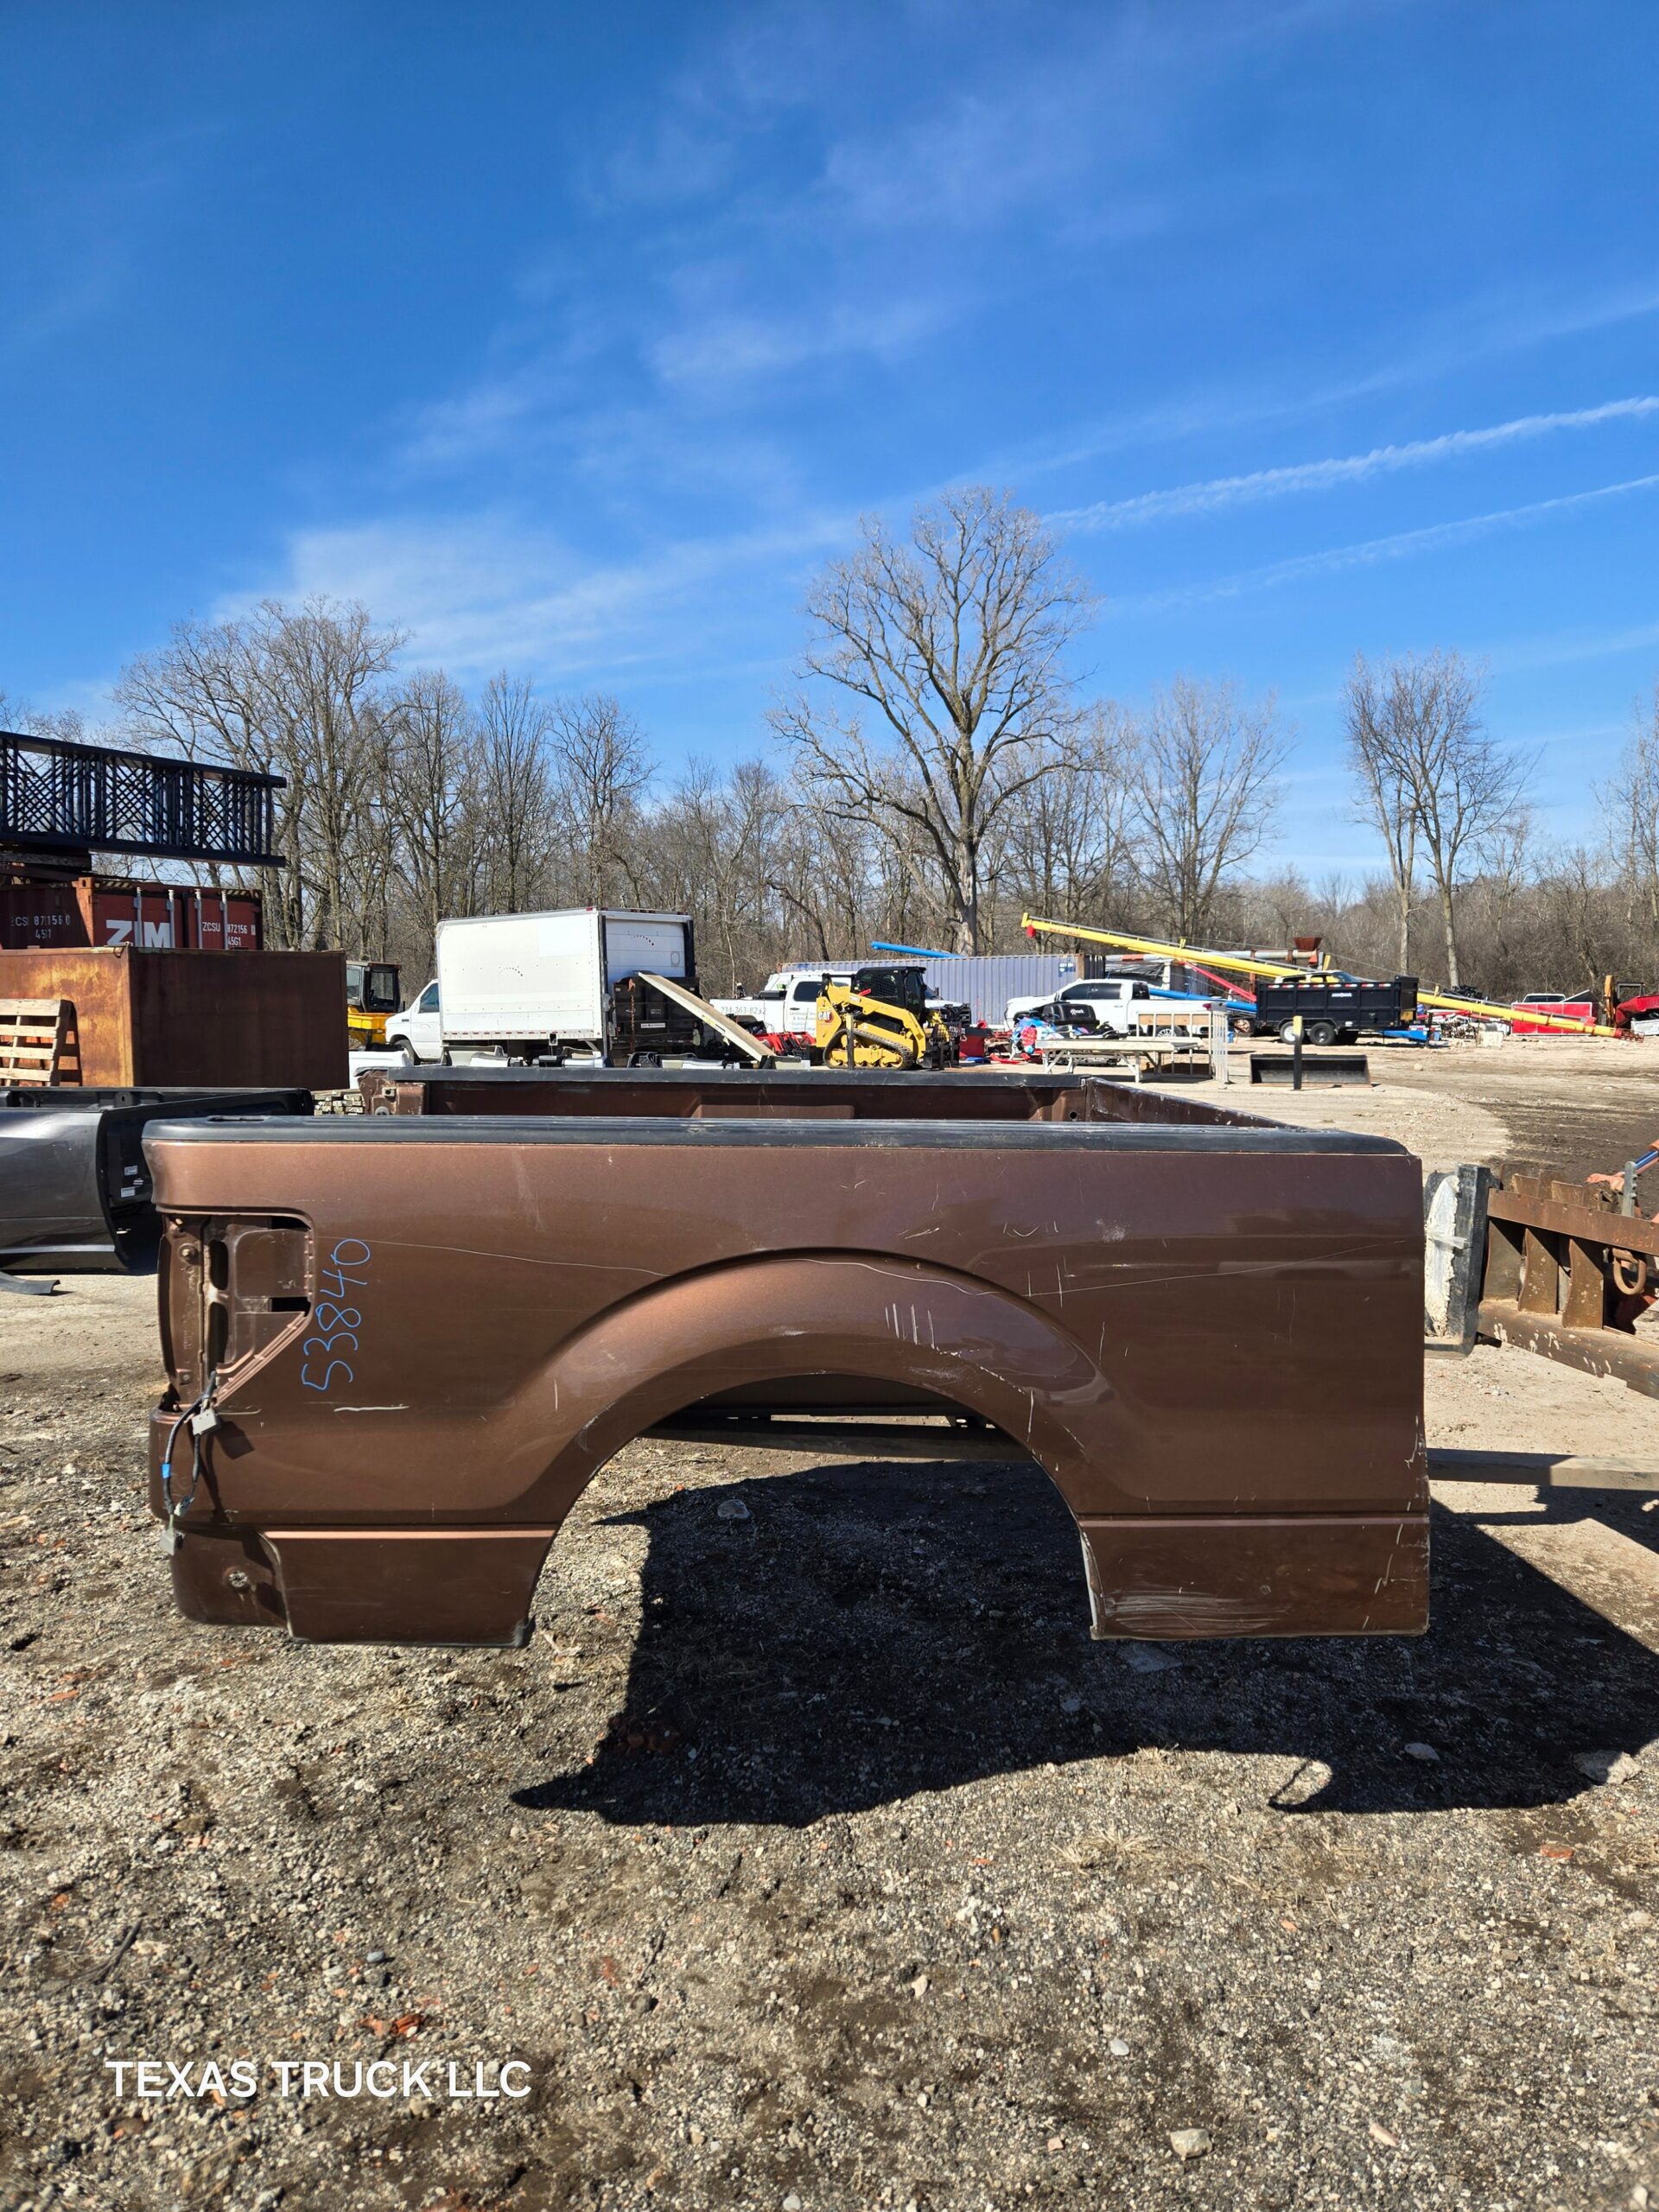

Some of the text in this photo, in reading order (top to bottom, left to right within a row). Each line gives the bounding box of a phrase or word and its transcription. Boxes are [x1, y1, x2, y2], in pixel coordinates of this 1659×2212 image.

[10, 917, 29, 926] CS
[35, 915, 62, 925] 87156
[202, 921, 221, 932] ZCSU
[35, 929, 52, 939] 451
[106, 919, 173, 948] ZIM
[817, 1012, 830, 1020] CAT
[302, 1238, 372, 1391] 53840
